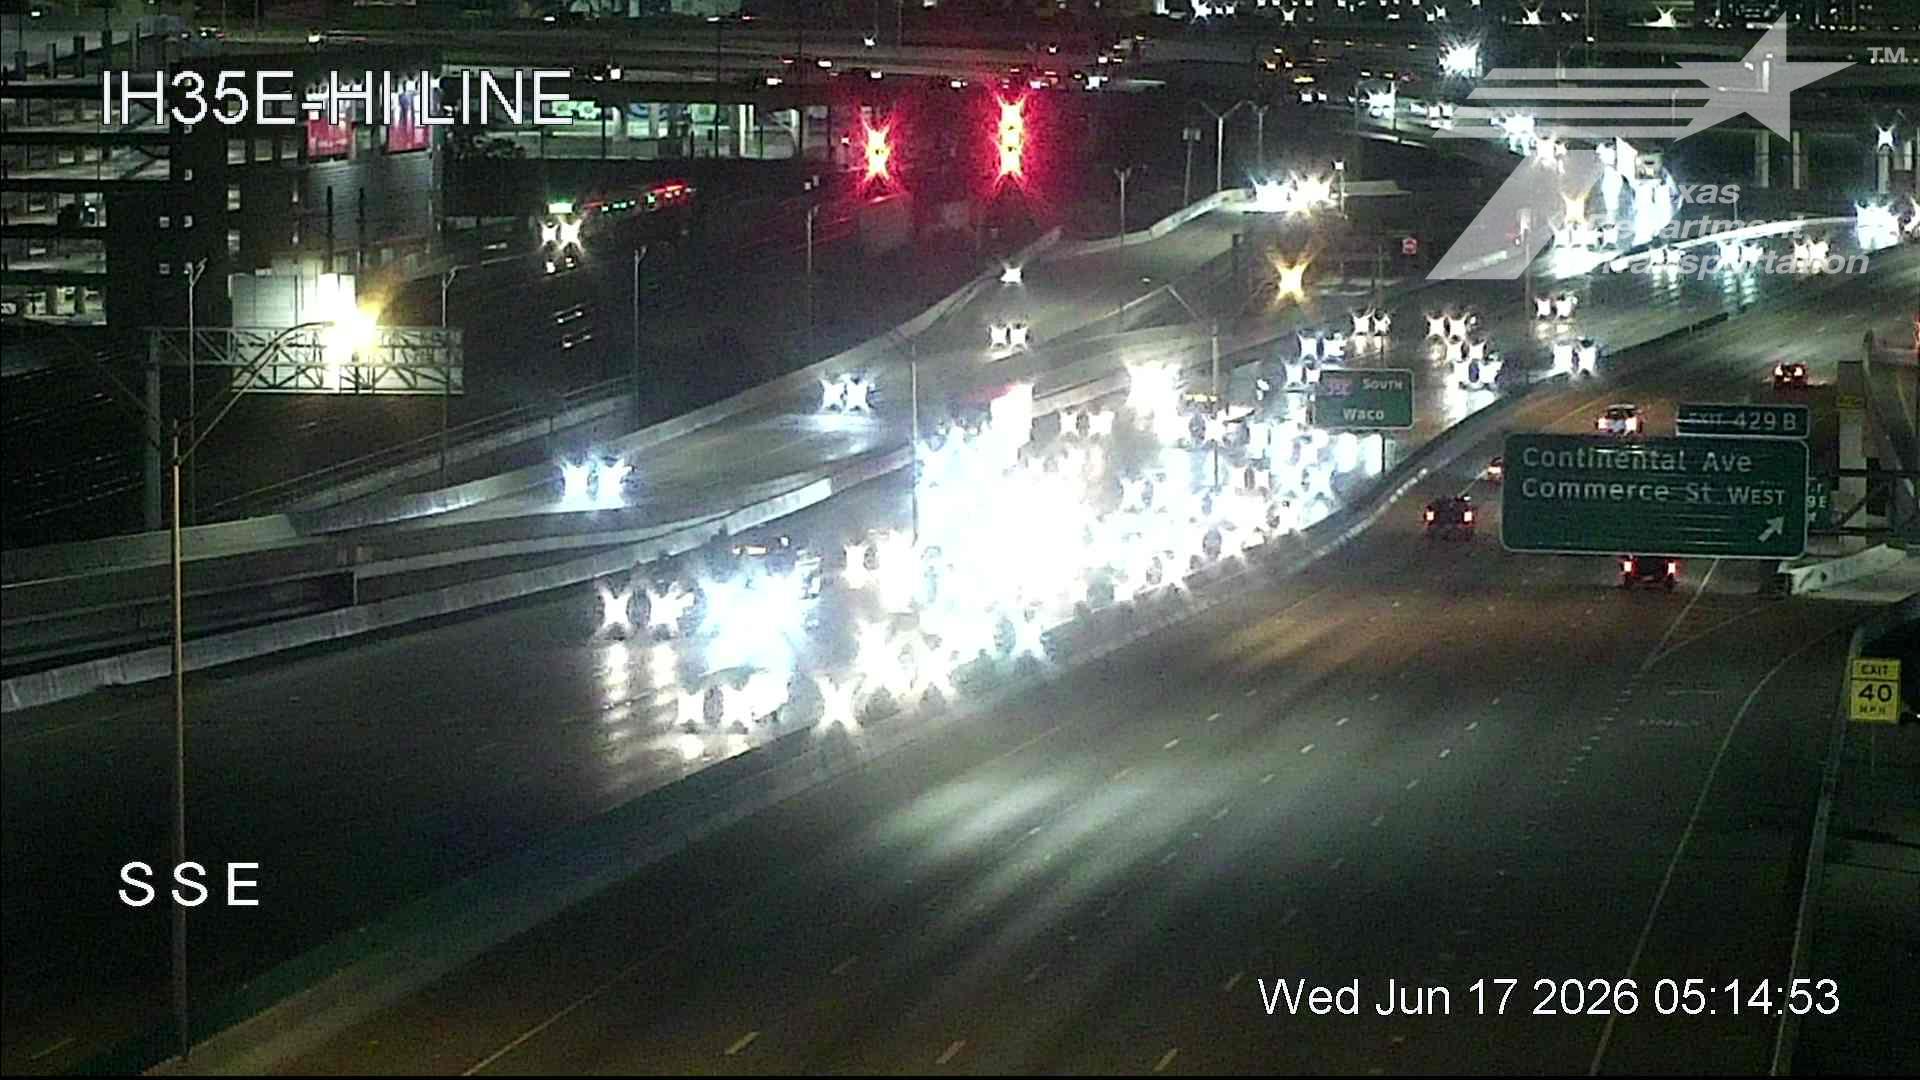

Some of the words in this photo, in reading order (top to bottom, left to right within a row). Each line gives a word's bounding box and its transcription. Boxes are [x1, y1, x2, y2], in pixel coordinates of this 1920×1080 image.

[1342, 407, 1385, 421] Waco
[1734, 410, 1778, 431] 429
[1783, 411, 1797, 431] B
[1521, 447, 1687, 472] Continental
[1701, 450, 1753, 473] Ave
[1521, 476, 1670, 502] Commerce
[1684, 480, 1713, 503] St
[1727, 486, 1786, 506] WEST
[1857, 683, 1893, 703] 40
